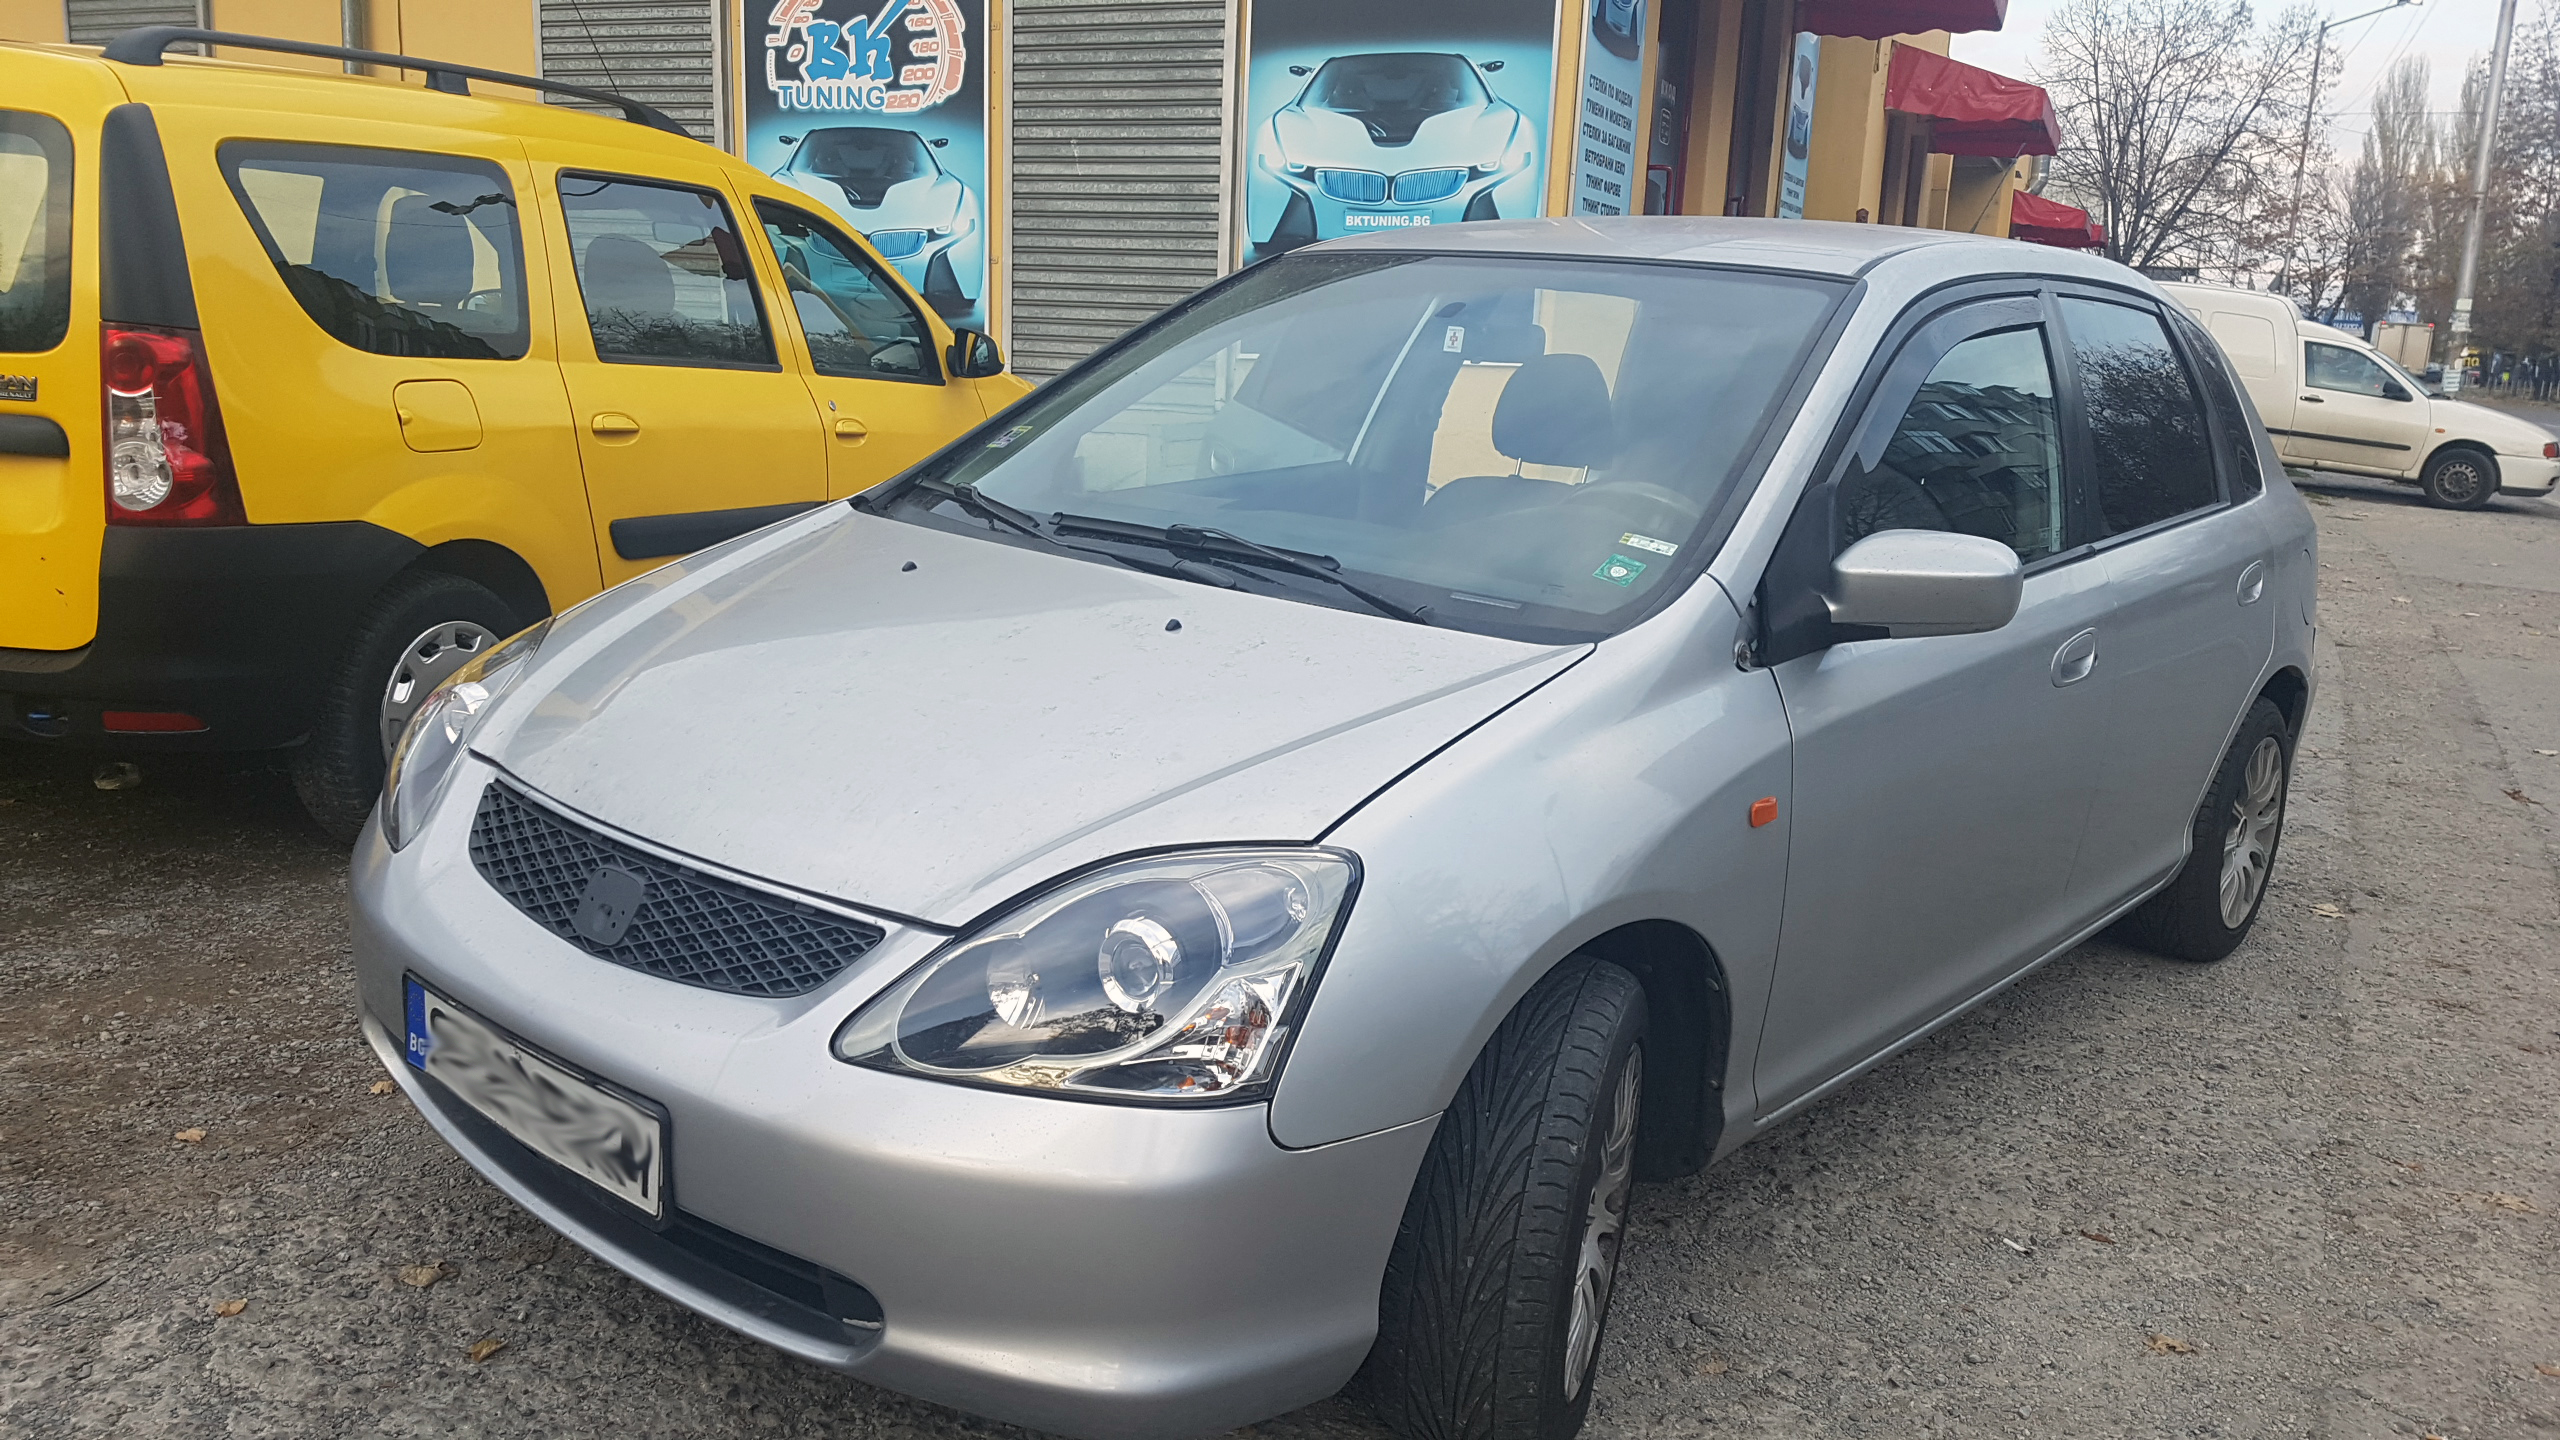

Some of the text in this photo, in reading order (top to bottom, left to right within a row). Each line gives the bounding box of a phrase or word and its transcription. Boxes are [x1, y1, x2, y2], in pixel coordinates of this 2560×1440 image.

[908, 16, 934, 28] 160
[805, 4, 905, 83] BK
[912, 41, 940, 54] 180
[903, 67, 936, 82] 200
[778, 85, 885, 109] TUNING
[885, 93, 922, 110] 220
[1585, 173, 1604, 192] ТУНИНГ
[1345, 215, 1431, 227] BKTUNING.BG
